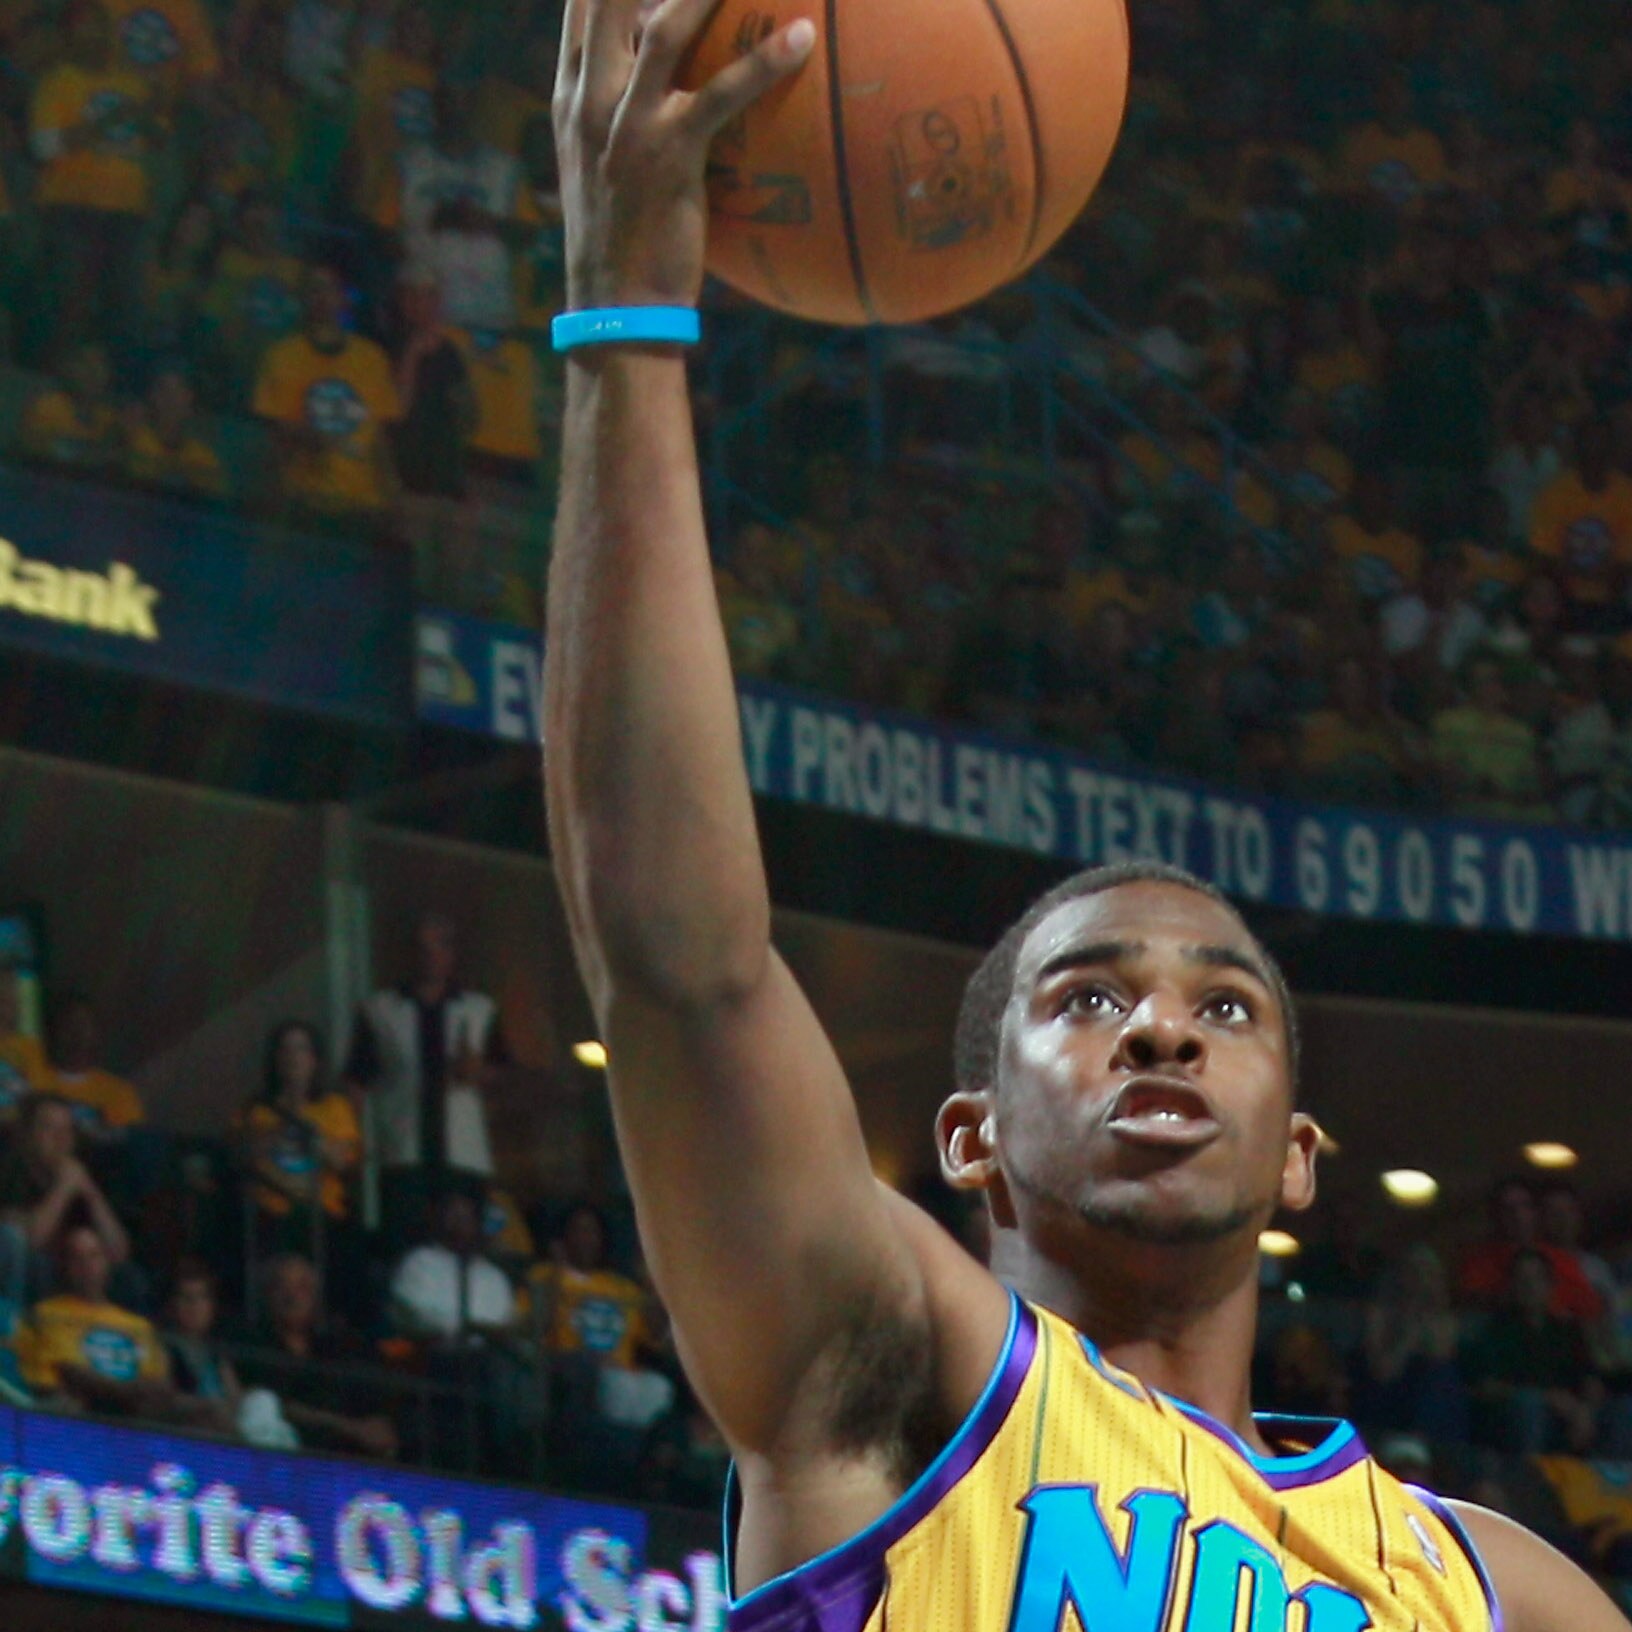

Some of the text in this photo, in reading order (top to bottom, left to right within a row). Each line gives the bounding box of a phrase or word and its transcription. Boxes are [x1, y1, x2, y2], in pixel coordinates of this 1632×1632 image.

[796, 708, 1056, 854] PROBLEMS
[1066, 769, 1194, 869] TEXT
[1211, 798, 1272, 899] TO
[336, 1493, 541, 1631] Old
